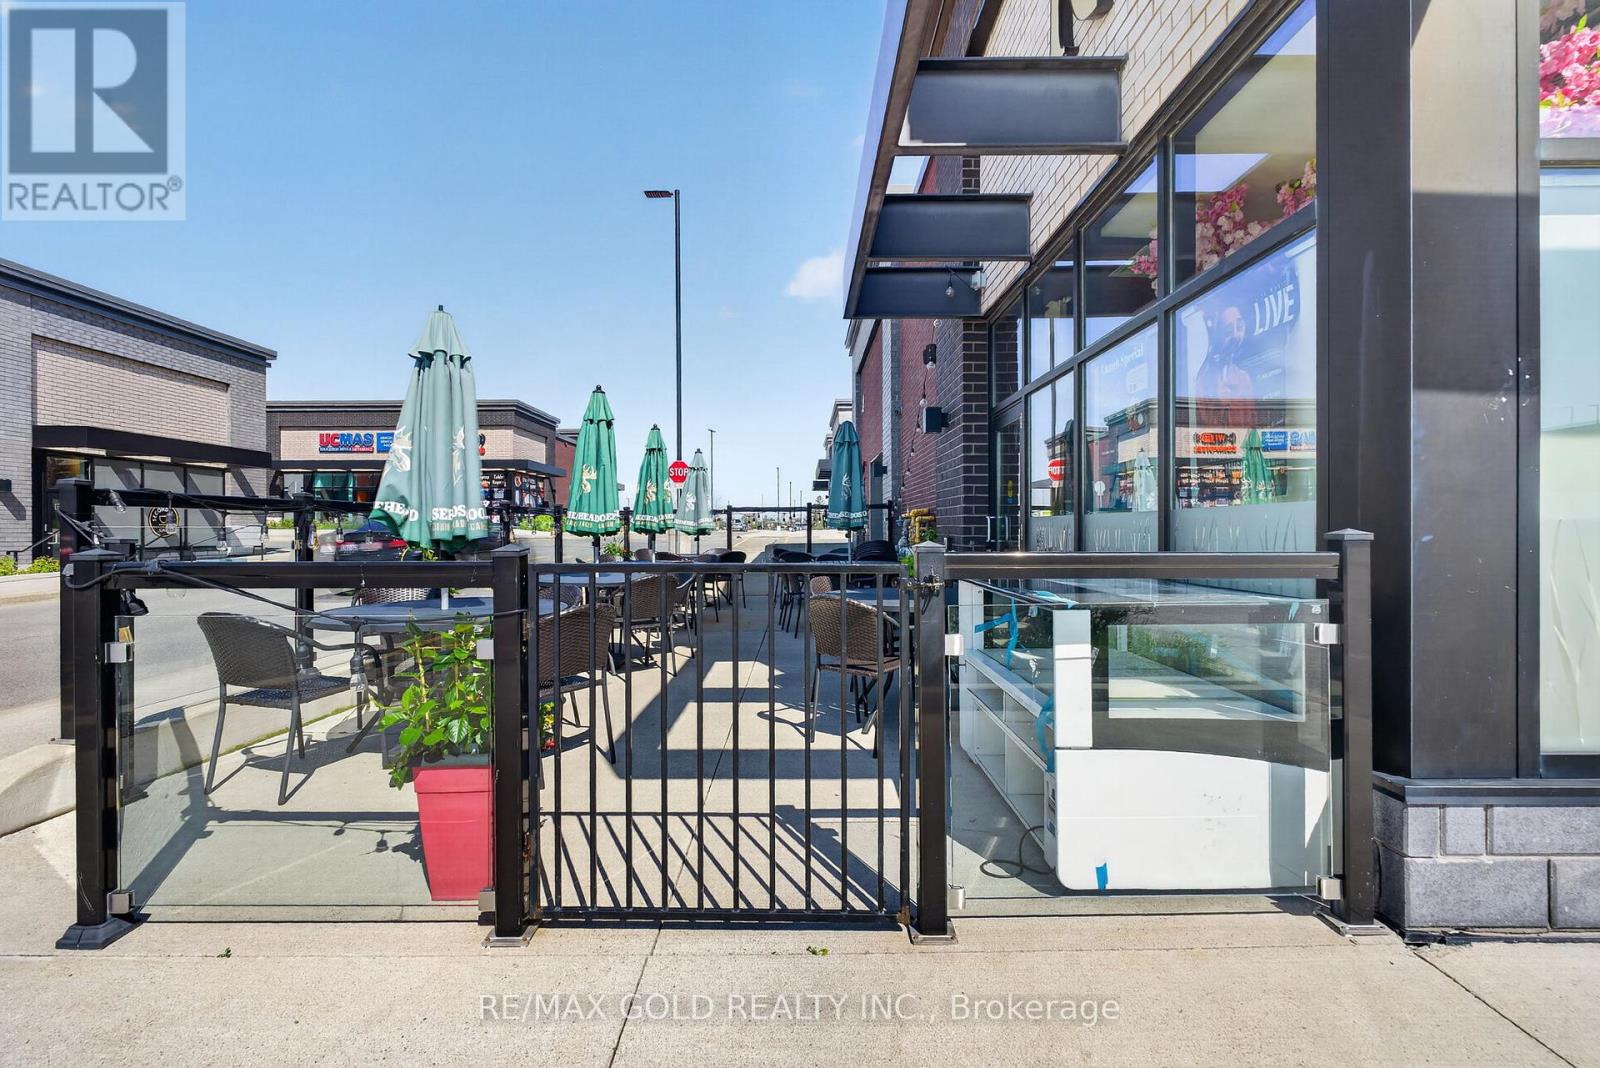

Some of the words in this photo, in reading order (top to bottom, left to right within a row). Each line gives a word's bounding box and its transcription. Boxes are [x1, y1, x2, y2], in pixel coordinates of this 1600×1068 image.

[1254, 284, 1295, 336] LIVE
[319, 432, 375, 448] UCMAS
[670, 467, 689, 477] STOP
